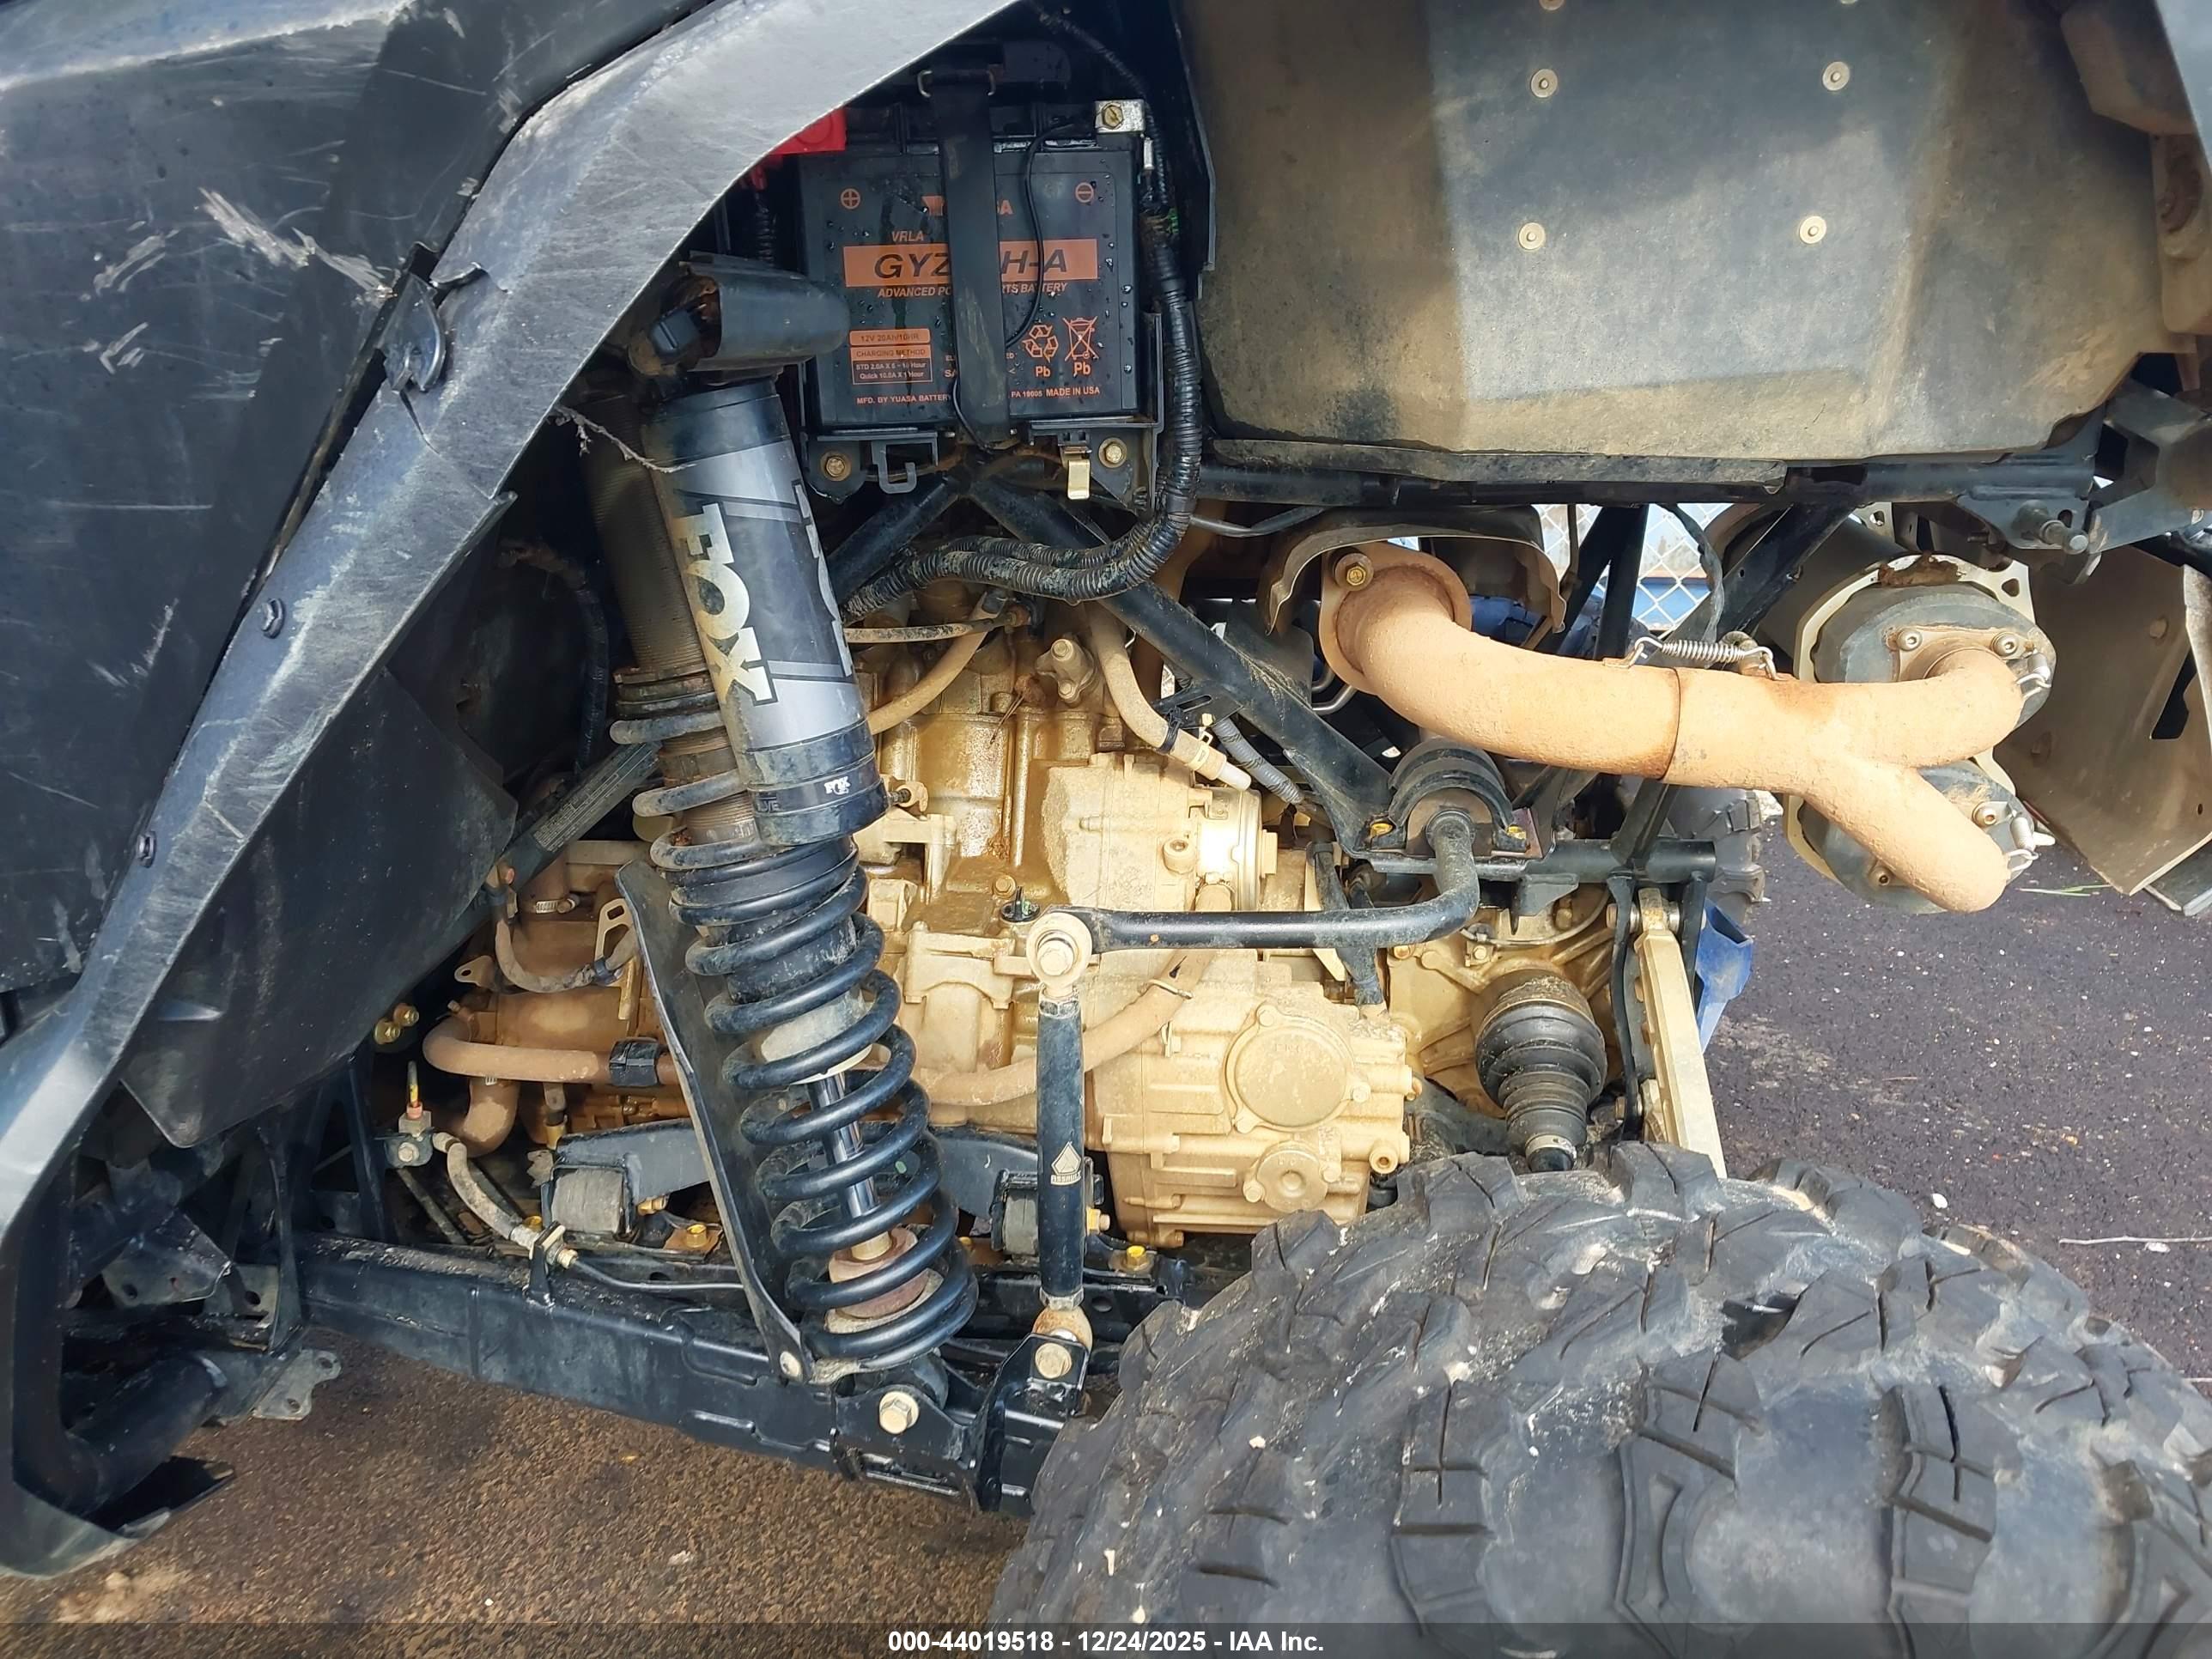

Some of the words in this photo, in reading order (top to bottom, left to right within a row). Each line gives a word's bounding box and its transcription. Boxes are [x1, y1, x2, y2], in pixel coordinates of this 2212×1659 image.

[891, 230, 924, 242] VRLA
[878, 287, 936, 298] ADVANCED
[1020, 282, 1068, 294] BATERY
[1036, 366, 1051, 377] Pb
[1074, 362, 1091, 375] Pb
[1045, 387, 1071, 397] MADE
[1073, 386, 1081, 396] IN
[1083, 386, 1100, 395] USA
[675, 502, 773, 702] FOX
[824, 775, 851, 795] FOX
